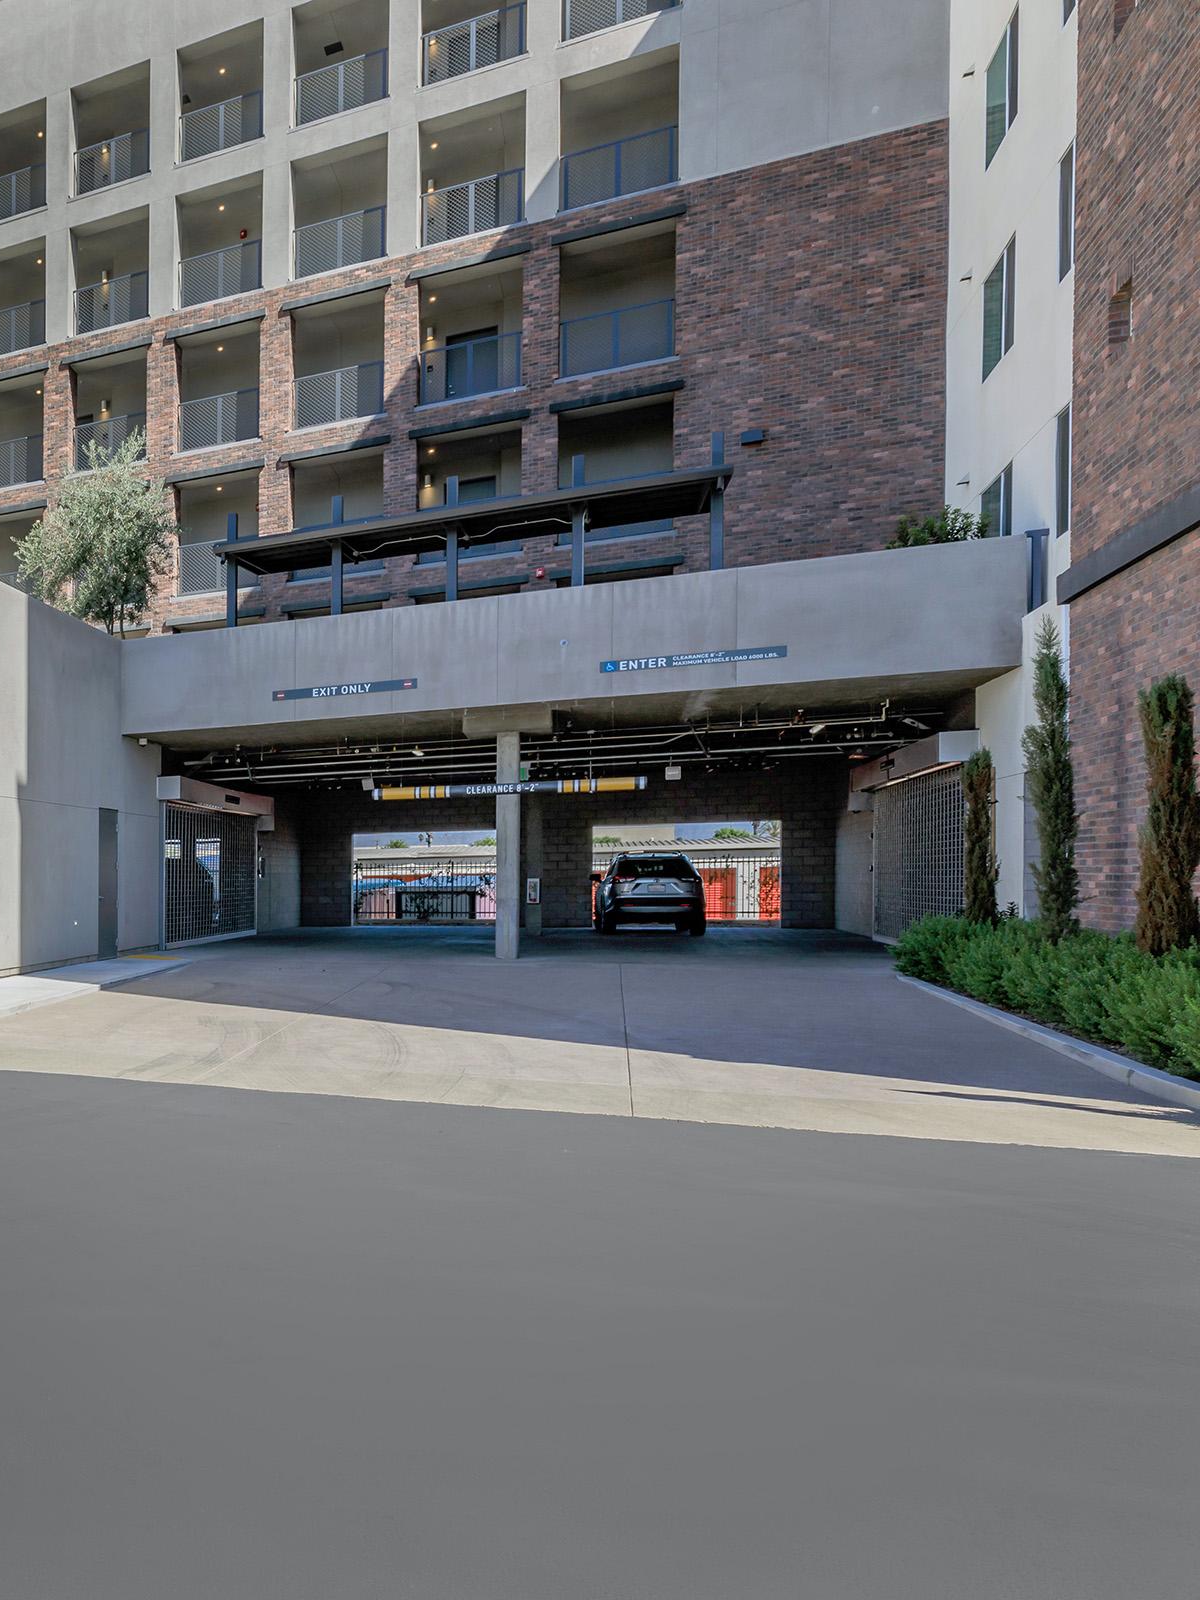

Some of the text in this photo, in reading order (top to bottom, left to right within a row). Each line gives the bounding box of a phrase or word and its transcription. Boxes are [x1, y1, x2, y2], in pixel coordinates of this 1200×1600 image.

[672, 653, 708, 661] CLEARANCE
[672, 658, 704, 667] MAXIMUM
[704, 656, 730, 664] VEHICLE
[620, 657, 667, 671] ENTER
[312, 684, 371, 697] EXIT ONLY
[466, 784, 514, 795] CLEARANCE
